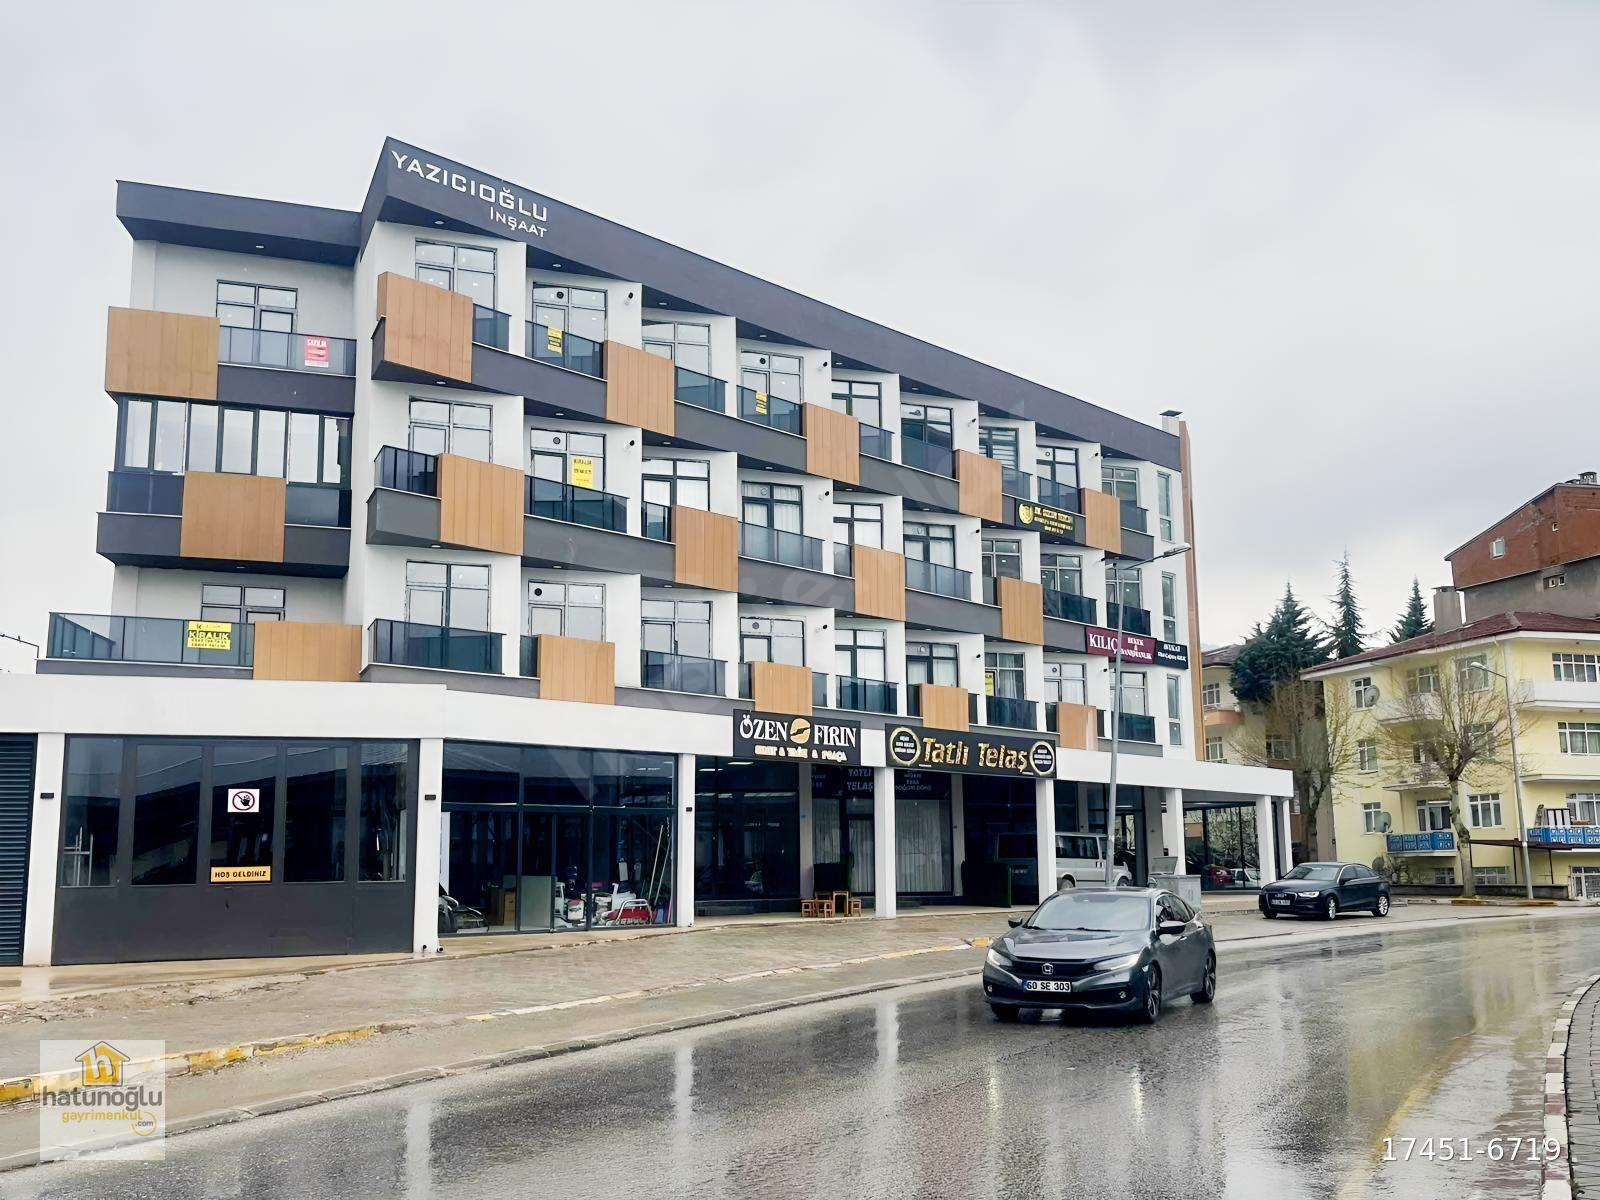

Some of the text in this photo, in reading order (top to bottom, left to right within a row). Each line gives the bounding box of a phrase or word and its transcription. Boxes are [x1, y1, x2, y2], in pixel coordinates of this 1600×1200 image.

[391, 150, 547, 222] YAZICIOĞLU
[1089, 633, 1118, 655] KILIÇ
[740, 714, 857, 747] ÖZEN FIRIN
[922, 737, 1028, 773] Tatlı Telaş
[1040, 982, 1051, 990] SE
